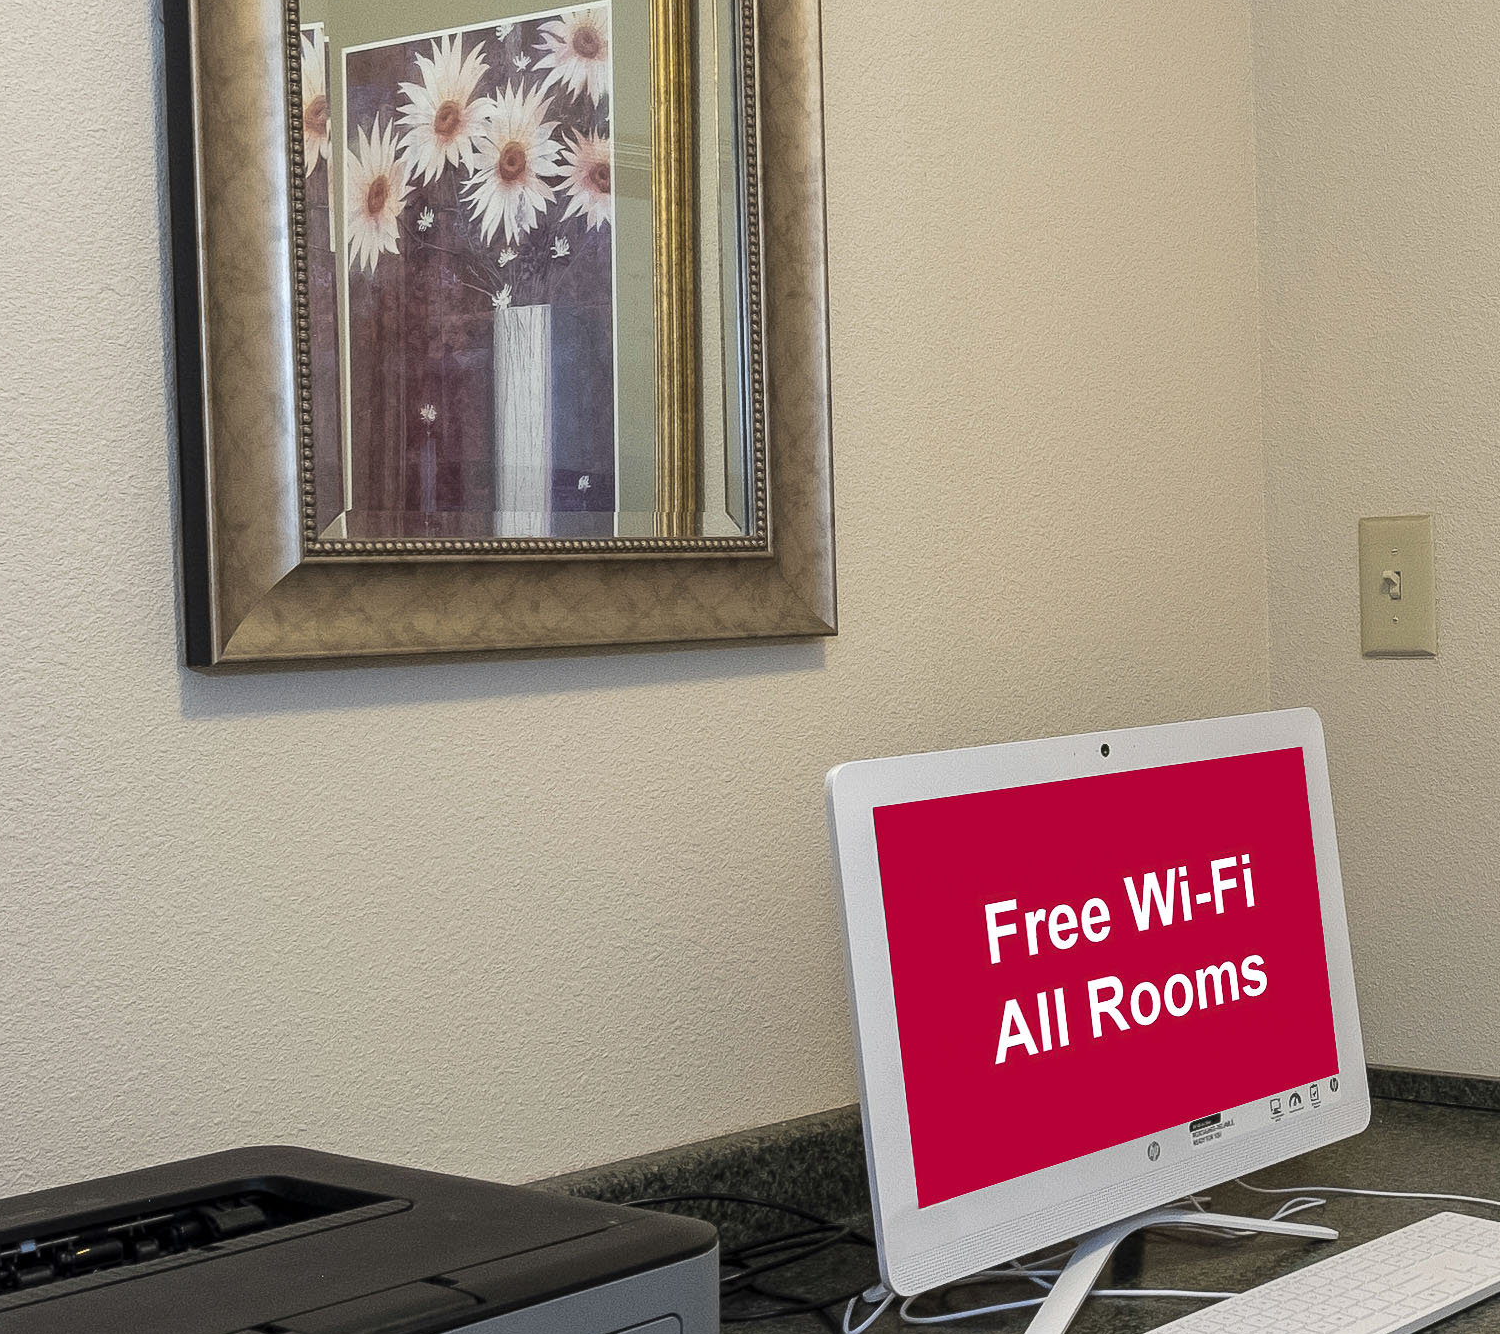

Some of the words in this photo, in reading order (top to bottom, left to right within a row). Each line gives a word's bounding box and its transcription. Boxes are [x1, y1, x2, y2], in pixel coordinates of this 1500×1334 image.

[984, 898, 1111, 965] Free
[1123, 853, 1255, 932] Wi-Fi
[994, 987, 1070, 1065] All
[1087, 954, 1268, 1039] Rooms
